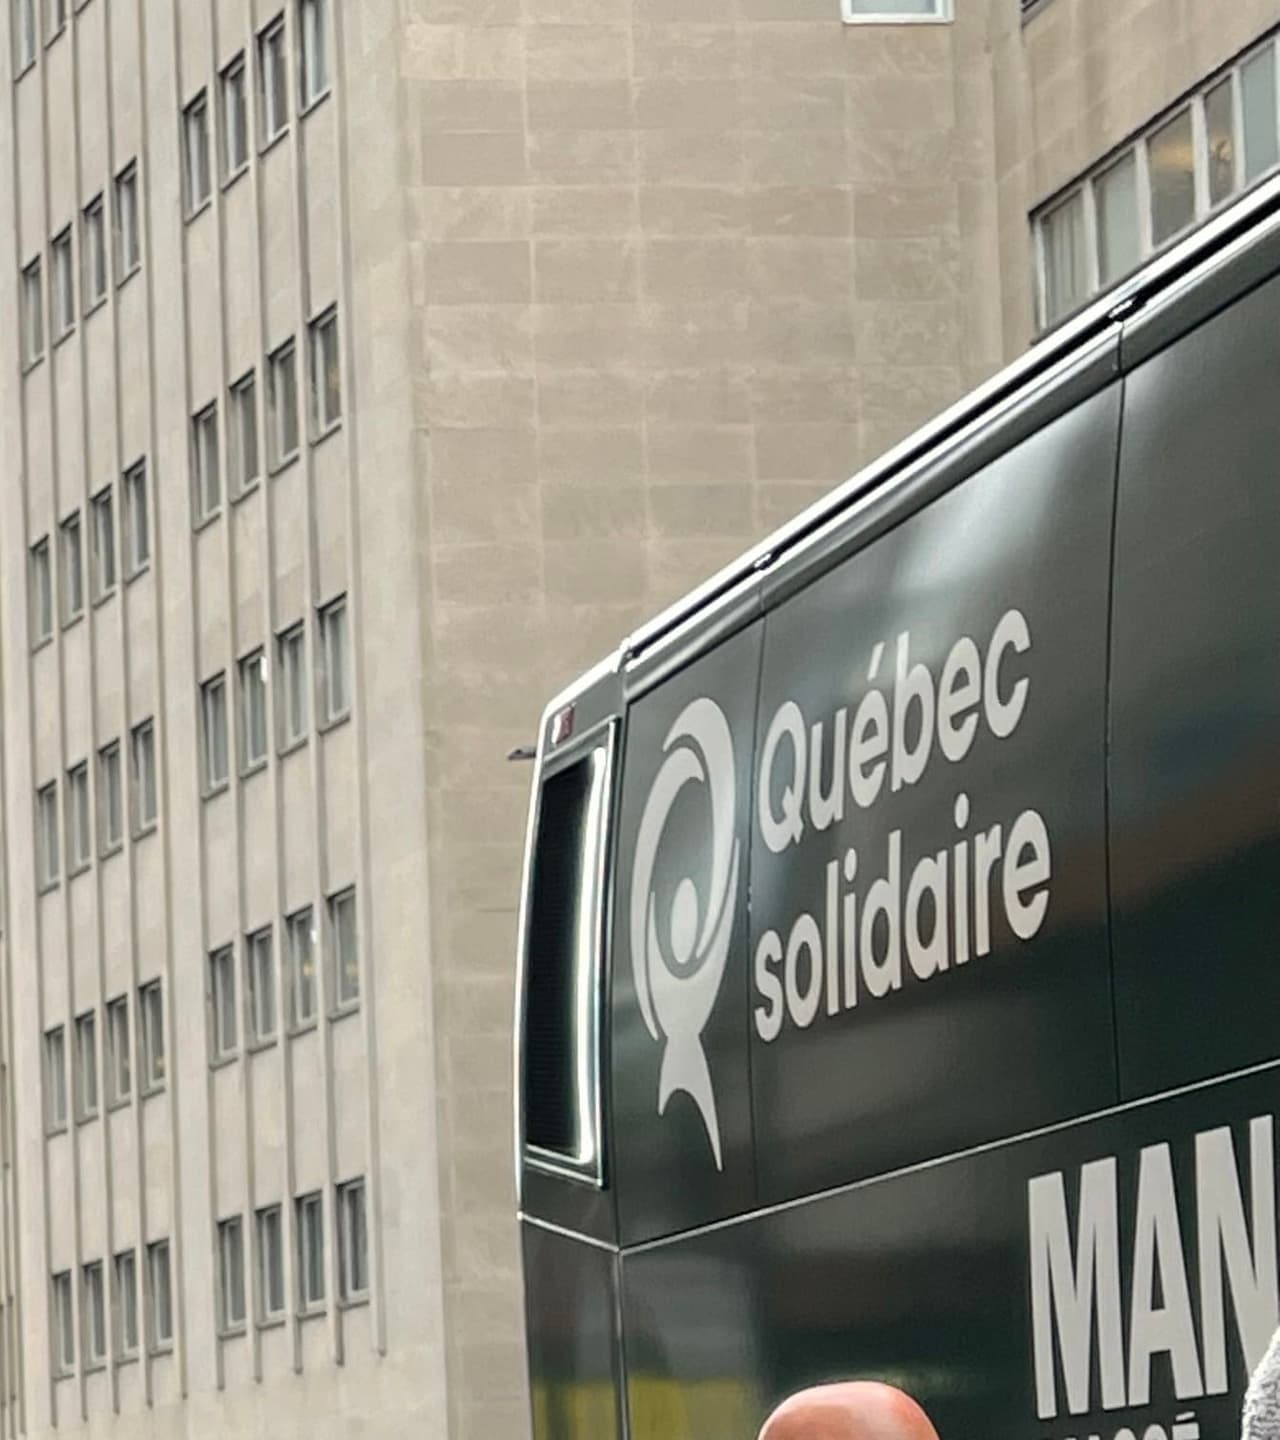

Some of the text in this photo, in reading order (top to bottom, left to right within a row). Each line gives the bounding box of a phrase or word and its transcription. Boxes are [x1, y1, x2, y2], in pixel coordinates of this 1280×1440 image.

[758, 608, 1031, 853] Québec
[754, 793, 1051, 1042] solidaire
[1028, 1114, 1280, 1419] MAN
